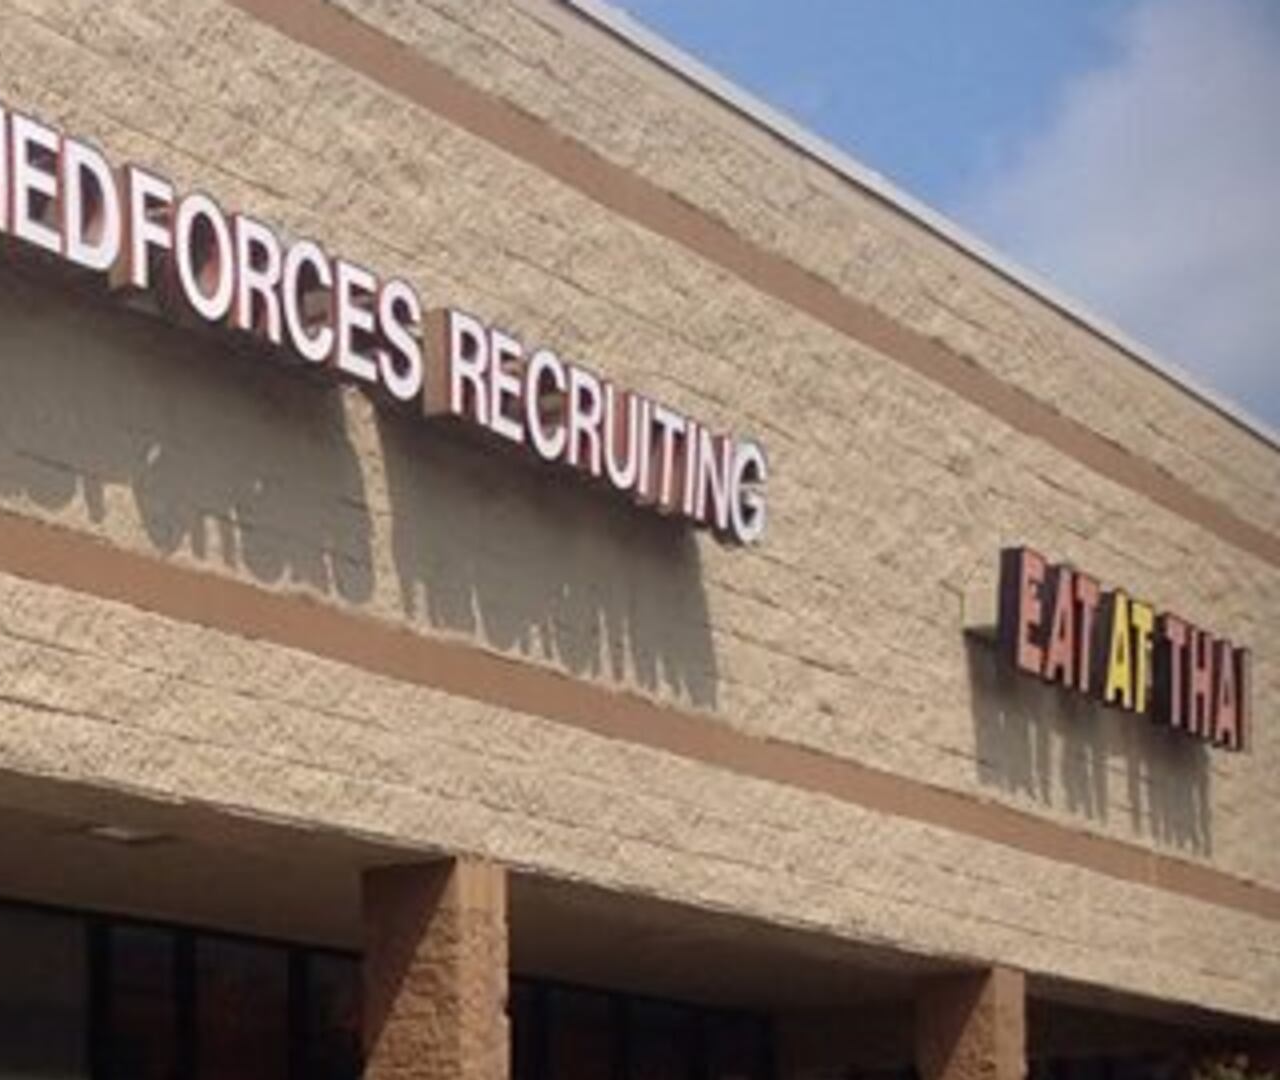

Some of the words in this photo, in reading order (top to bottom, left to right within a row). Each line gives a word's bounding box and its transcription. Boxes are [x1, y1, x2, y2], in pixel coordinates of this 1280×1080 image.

[126, 163, 423, 402] FORCES
[450, 306, 769, 546] RECRUITING
[1016, 544, 1101, 693] EAT
[1163, 610, 1252, 753] THAI
